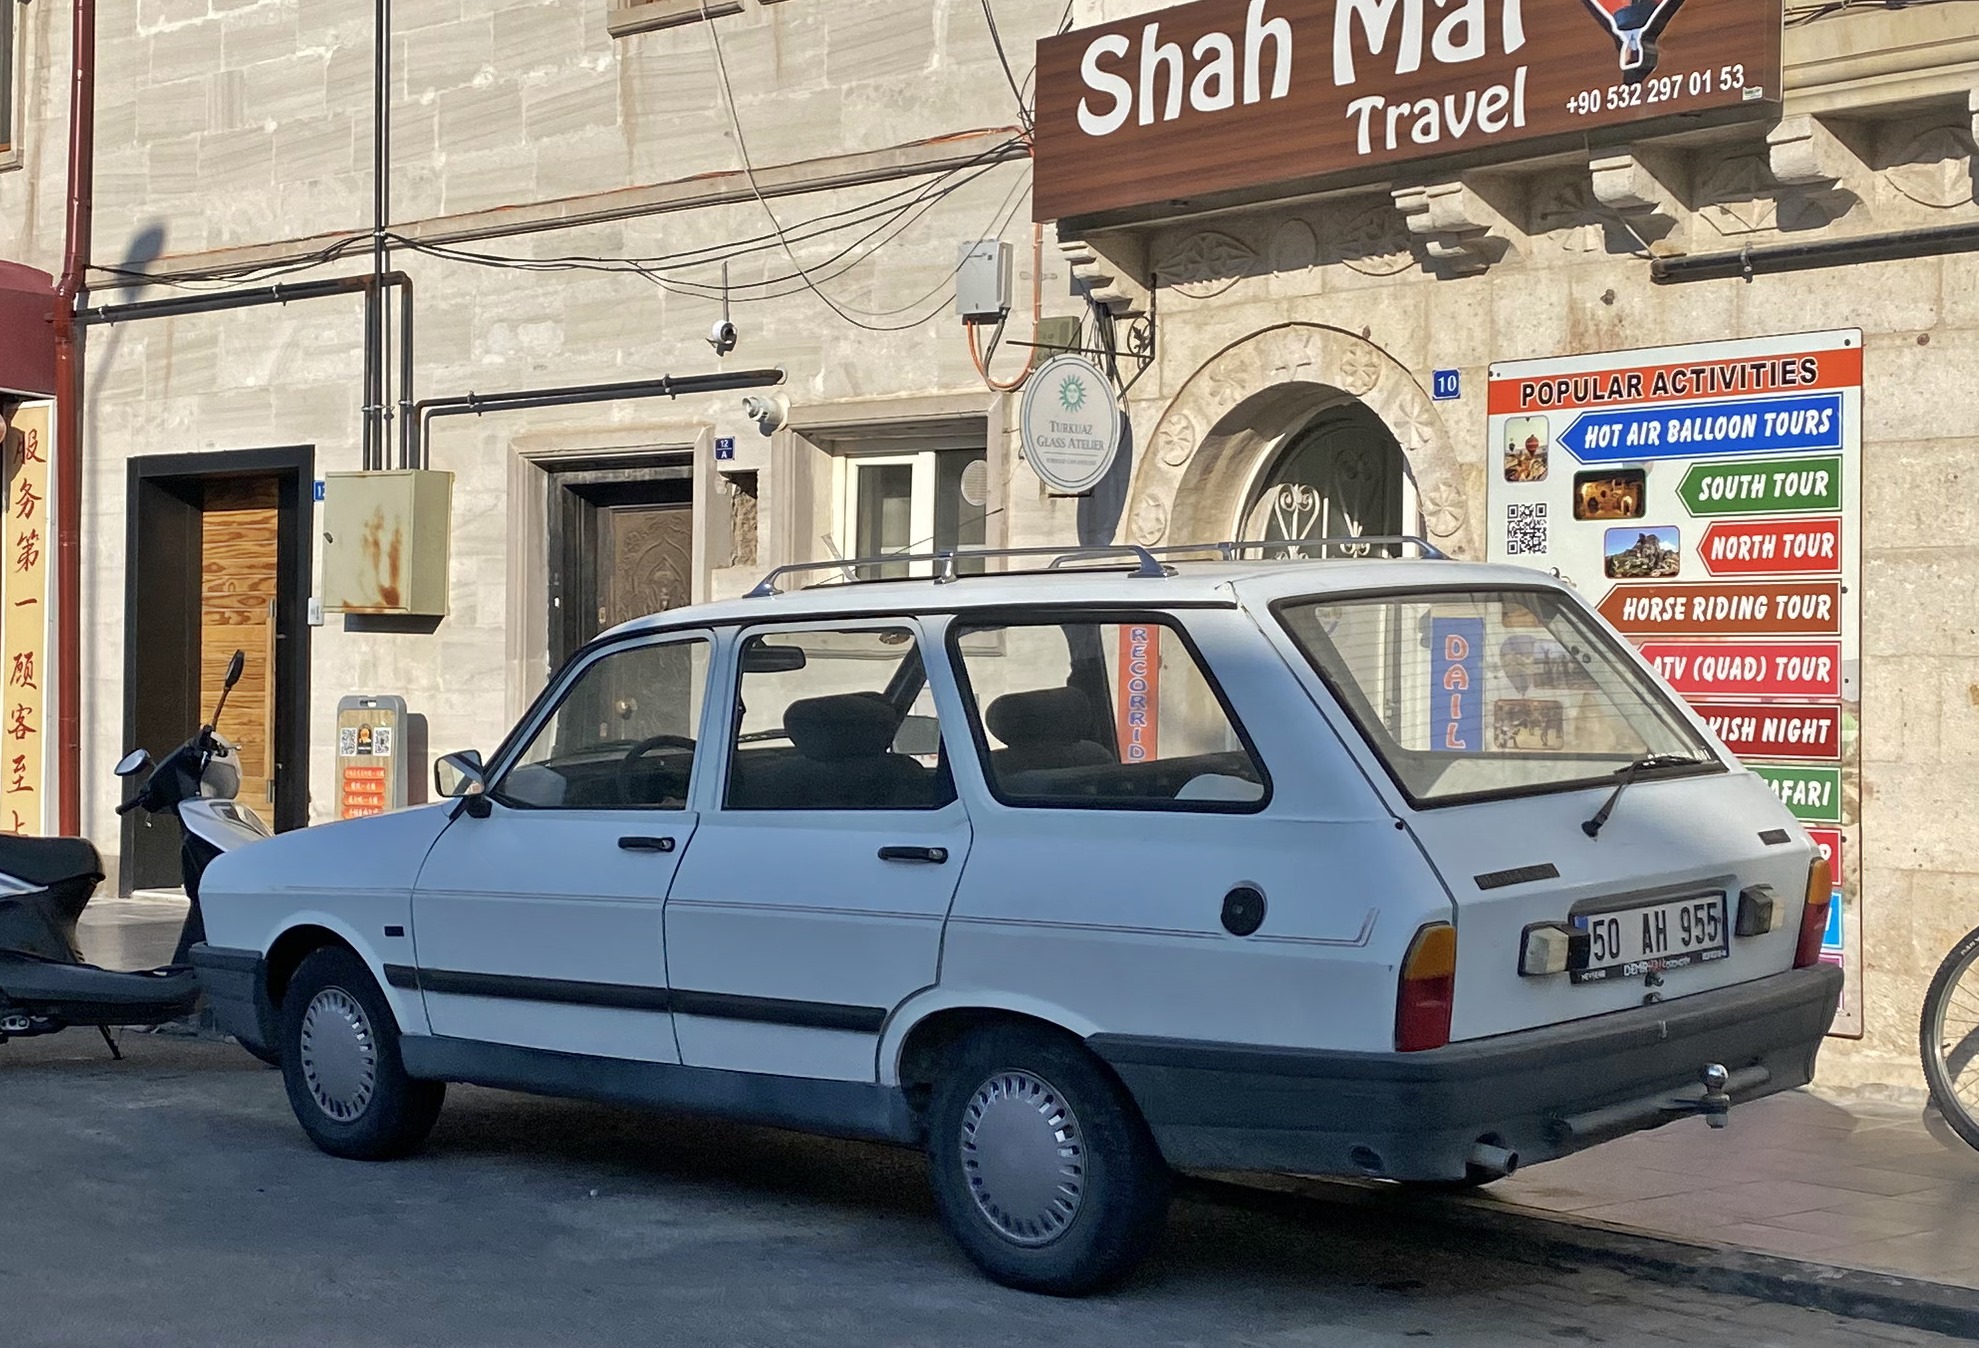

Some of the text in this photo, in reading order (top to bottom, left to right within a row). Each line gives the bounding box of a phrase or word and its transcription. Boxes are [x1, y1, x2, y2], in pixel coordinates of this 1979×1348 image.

[1076, 0, 1293, 136] Shah
[1566, 89, 1601, 115] +90
[1606, 82, 1642, 110] 532
[1647, 74, 1684, 104] 297
[1689, 69, 1712, 96] 01
[1719, 64, 1744, 91] 53
[1346, 66, 1528, 155] Travel
[1437, 374, 1457, 393] 10
[1521, 357, 1818, 407] POPULAR ACTIVITIES
[720, 439, 729, 448] 12
[1585, 408, 1833, 449] HOT AIR BALLOON TOURS
[720, 450, 728, 459] A
[1698, 470, 1829, 501] SOUTH TOUR
[1711, 532, 1835, 561] NORTH TOUR
[1622, 594, 1832, 622] HORSE RIDING TOUR
[1652, 656, 1832, 683] ATV (QUAD) TOUR
[1128, 628, 1148, 764] RECORRID
[1700, 716, 1831, 744] KISH NIGHT
[1763, 779, 1831, 807] AFARI
[1592, 902, 1718, 961] 50 AH 955
